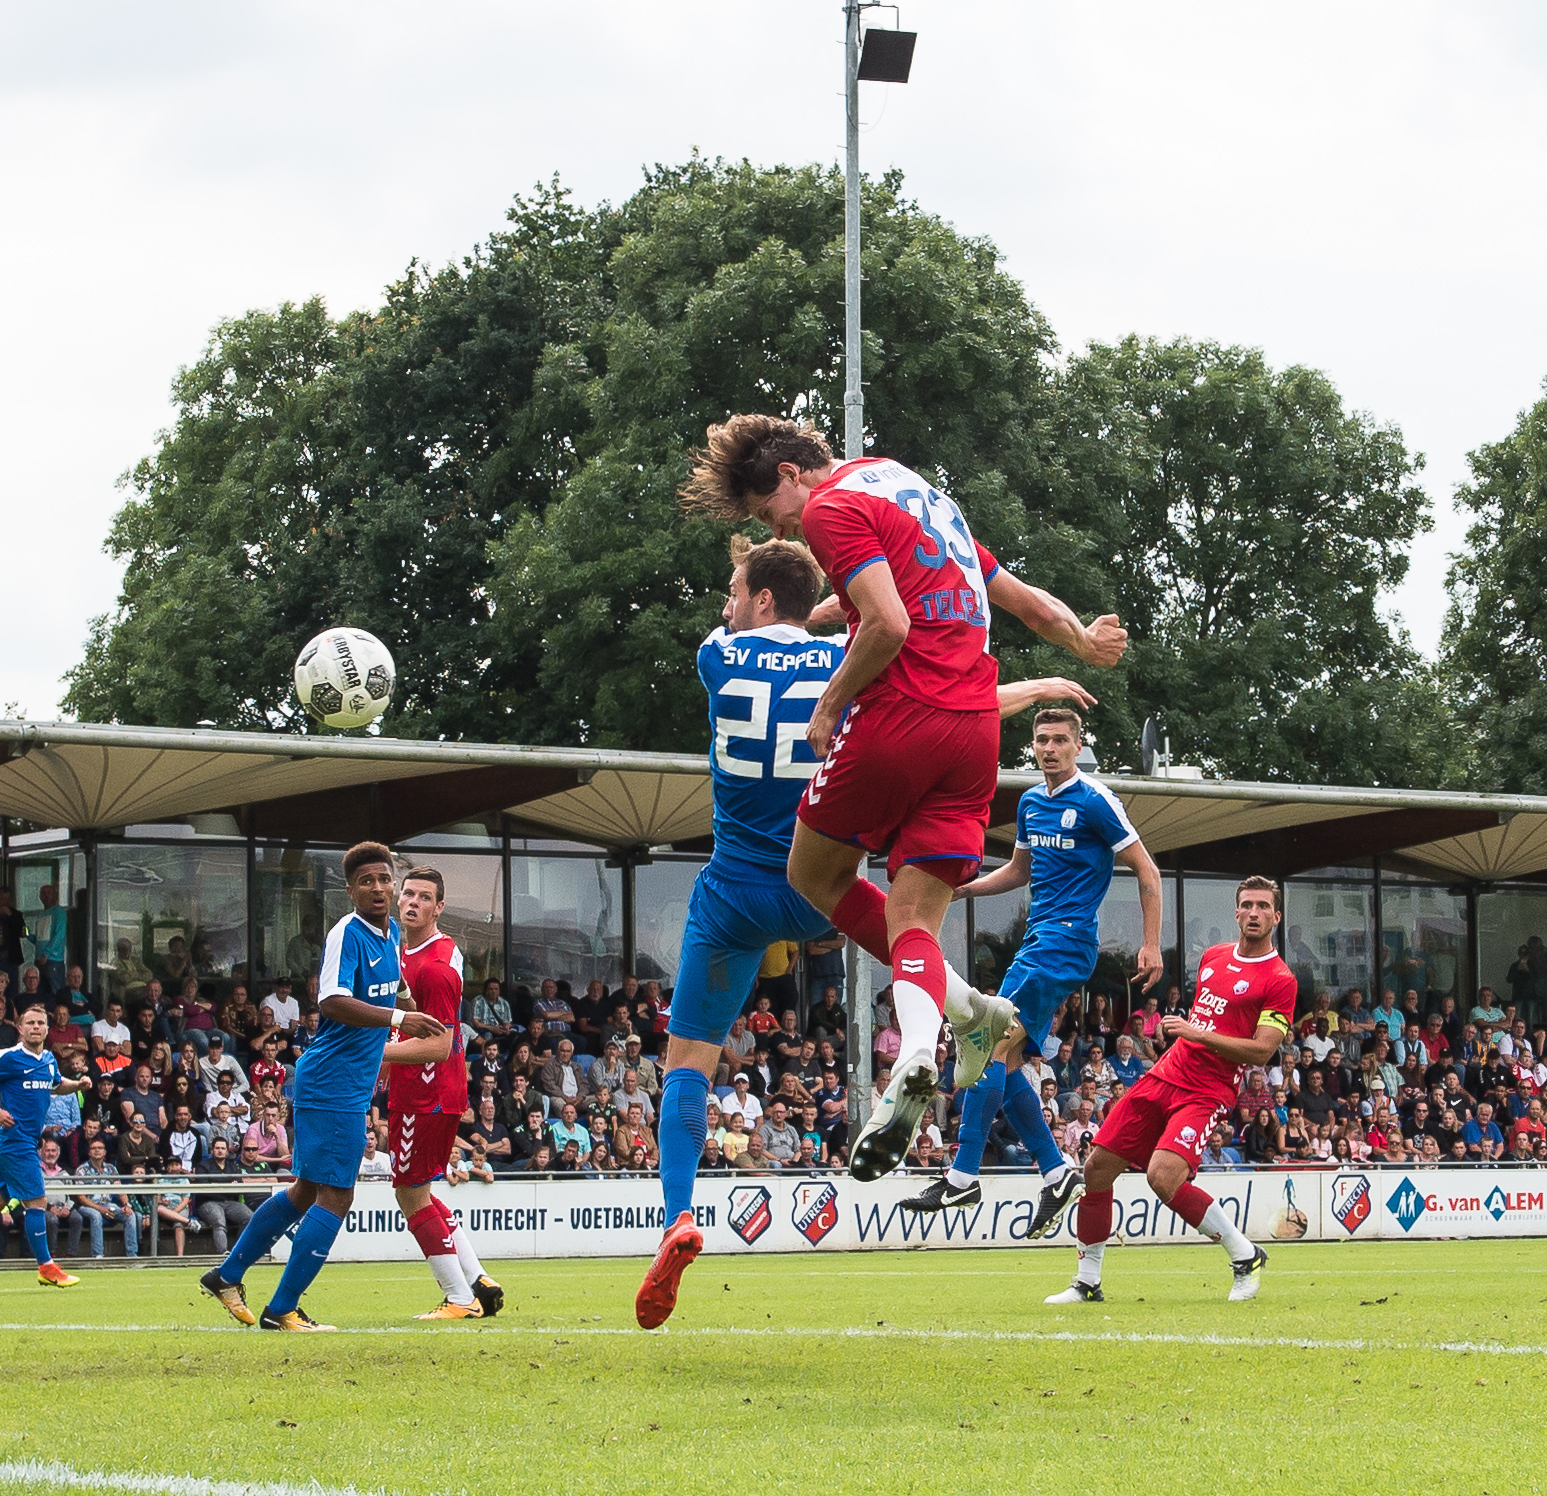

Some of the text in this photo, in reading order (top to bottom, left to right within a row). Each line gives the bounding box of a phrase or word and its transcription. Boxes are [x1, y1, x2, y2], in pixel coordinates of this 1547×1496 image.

[896, 489, 976, 569] 33
[331, 633, 362, 689] DERBYSTAR
[724, 647, 832, 671] SV MEPPEN
[715, 678, 831, 779] 22
[1028, 833, 1075, 850] awila
[1197, 986, 1228, 1015] Zorg
[798, 1186, 834, 1231] UTRECHT
[1337, 1179, 1369, 1221] UTRECHT
[1448, 1197, 1481, 1212] van
[346, 1210, 410, 1233] CLINIC
[470, 1208, 547, 1231] UTRECHT
[570, 1205, 716, 1230] VOETBALKAEN
